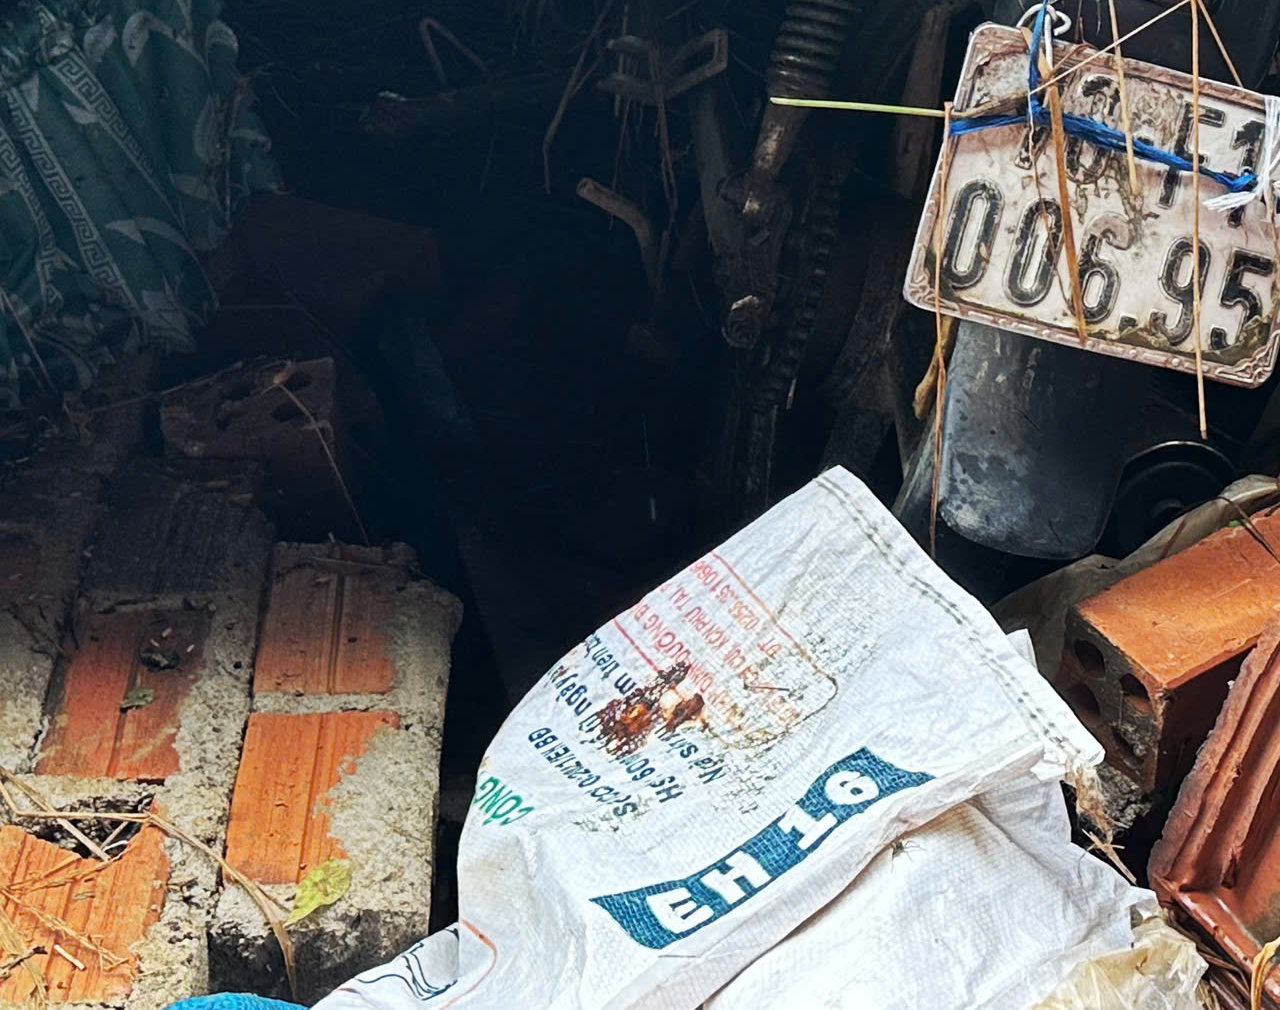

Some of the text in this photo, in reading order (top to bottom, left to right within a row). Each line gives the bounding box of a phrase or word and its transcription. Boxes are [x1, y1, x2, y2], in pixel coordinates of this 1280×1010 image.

[939, 177, 1277, 351] 006.95
[644, 767, 882, 936] EH 16
